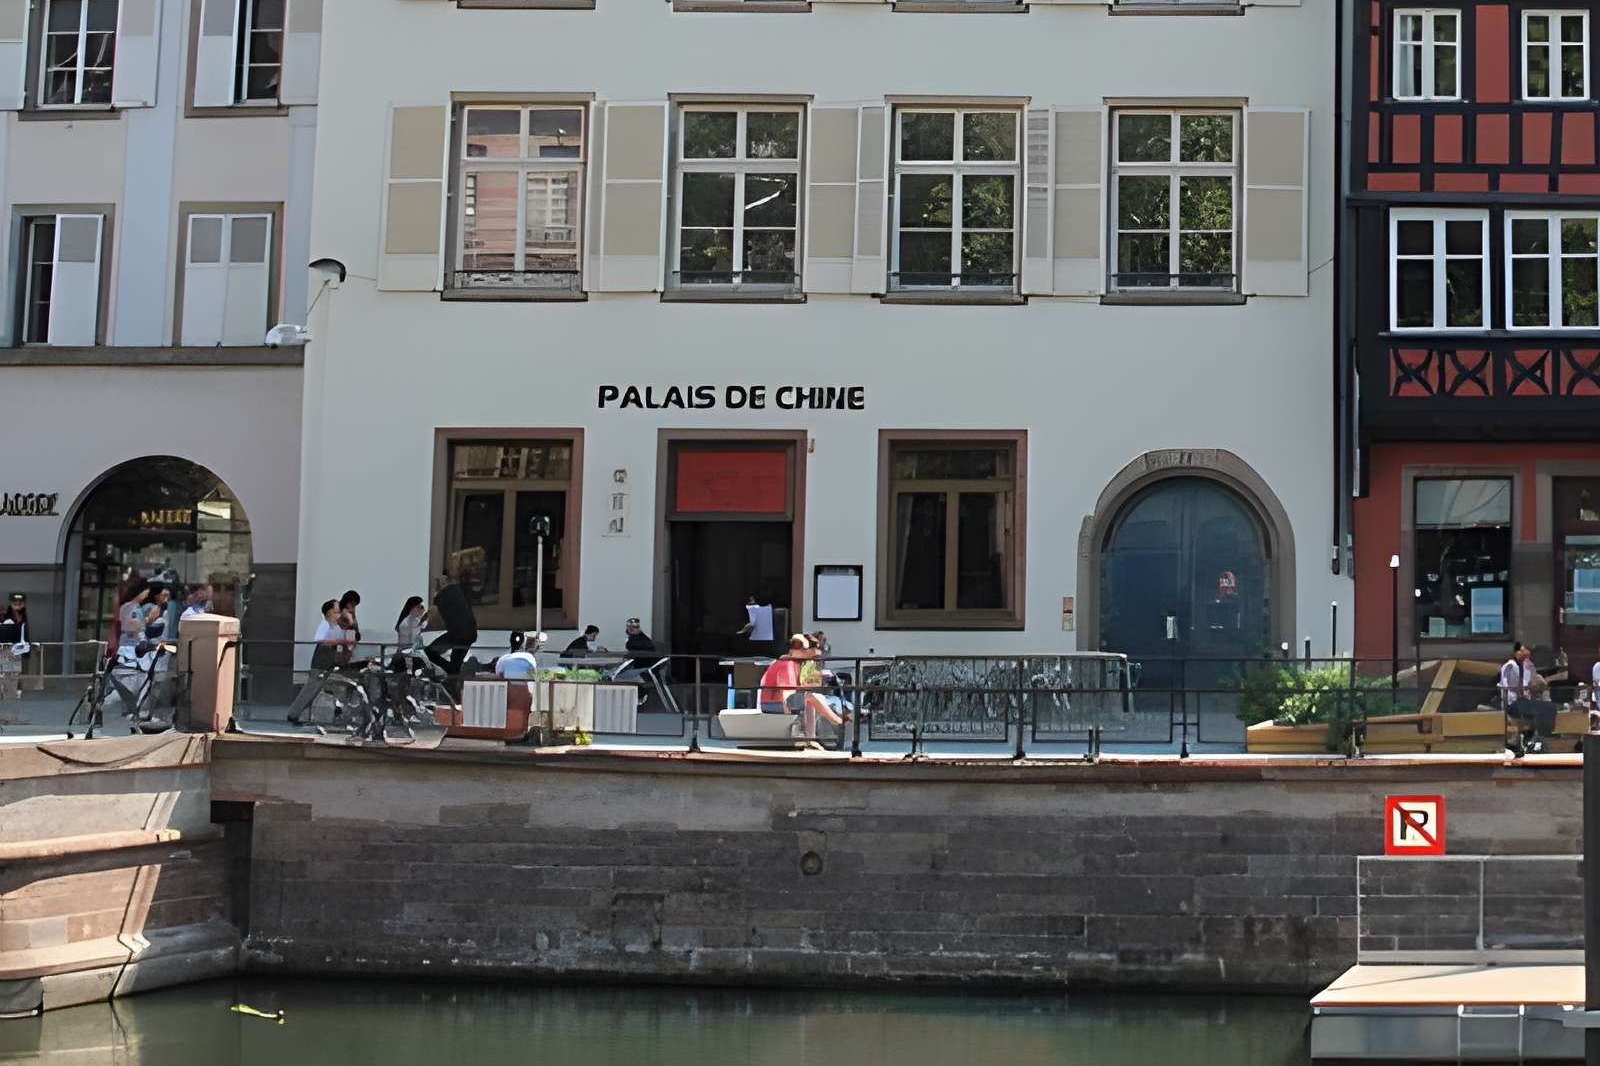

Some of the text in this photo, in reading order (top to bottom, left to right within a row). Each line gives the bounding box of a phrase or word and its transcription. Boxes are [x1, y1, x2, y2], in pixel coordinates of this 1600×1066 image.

[598, 385, 865, 410] PALAIS DE CHINE
